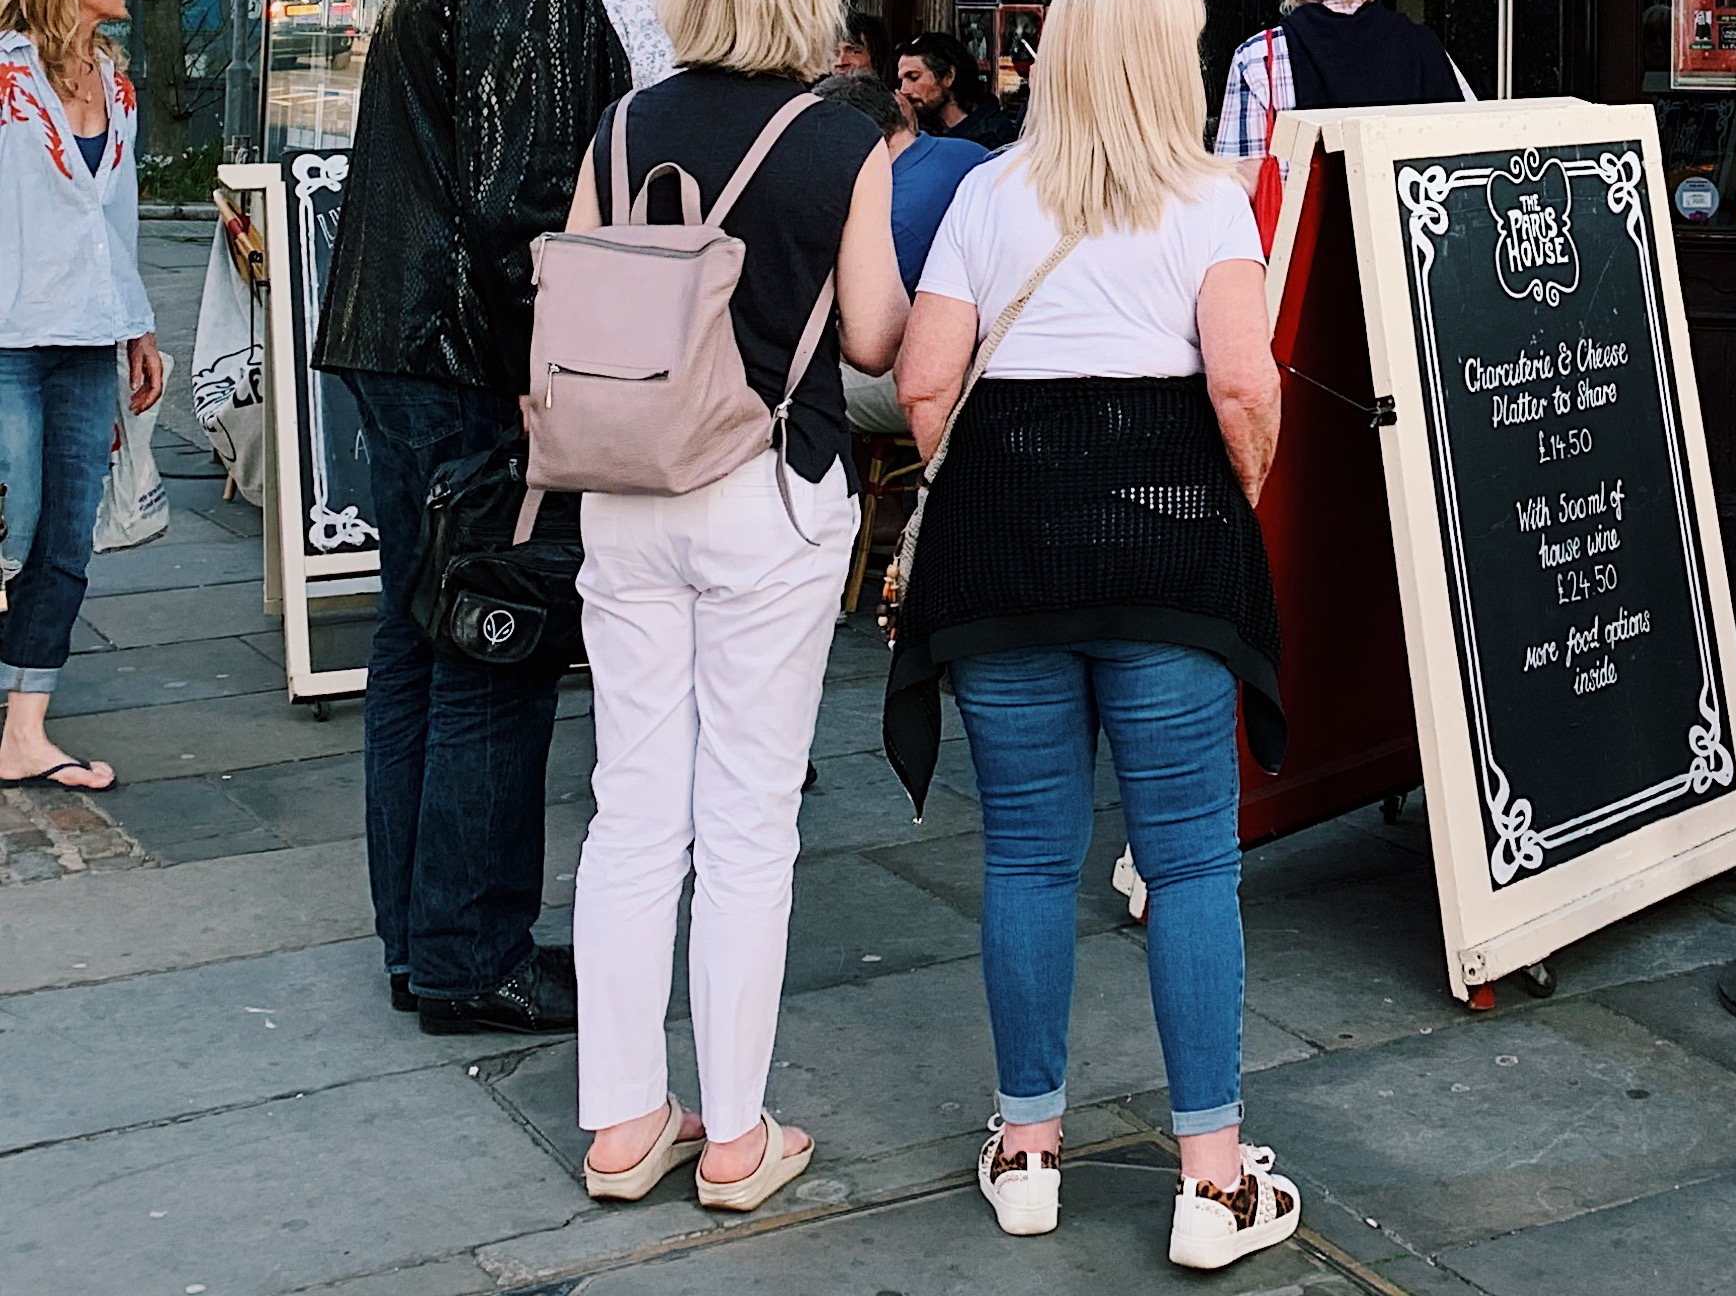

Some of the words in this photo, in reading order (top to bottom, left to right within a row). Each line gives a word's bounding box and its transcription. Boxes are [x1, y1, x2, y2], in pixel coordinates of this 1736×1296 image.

[1519, 194, 1541, 212] THE
[1507, 207, 1558, 243] PARIS
[1506, 236, 1570, 273] HOUSE
[1464, 349, 1554, 393] Charcuterie
[1558, 341, 1572, 376] &
[1577, 338, 1629, 370] Cheese
[1491, 395, 1548, 429] Platter
[1553, 386, 1572, 415] to
[1577, 377, 1618, 411] Share
[1538, 428, 1593, 464] £14.50
[1516, 497, 1551, 532] With
[1610, 479, 1625, 521] of
[1539, 533, 1581, 570] house
[1587, 525, 1621, 557] wine
[1557, 563, 1618, 604] £24.50
[1566, 615, 1600, 668] food
[1604, 606, 1651, 651] options
[1573, 655, 1618, 696] inside
